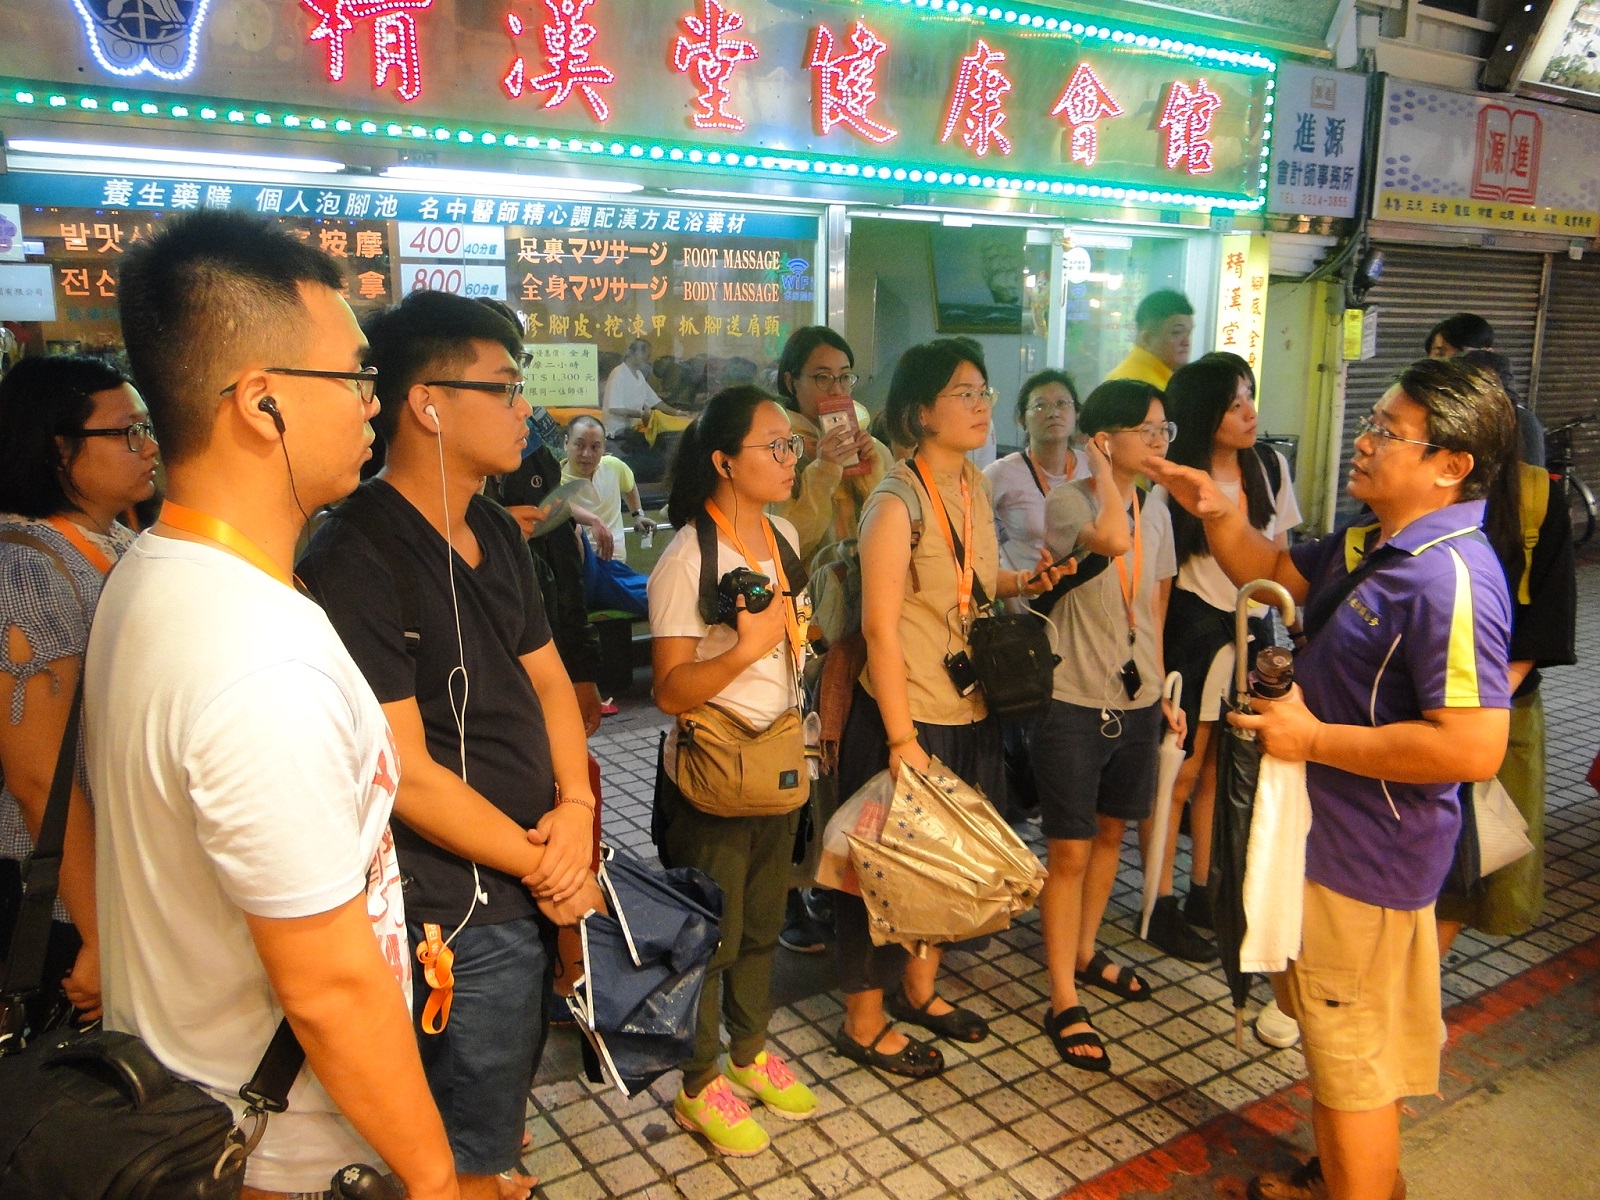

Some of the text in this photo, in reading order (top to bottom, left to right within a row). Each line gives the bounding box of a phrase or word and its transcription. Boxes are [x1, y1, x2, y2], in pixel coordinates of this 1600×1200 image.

[1277, 160, 1354, 191] 會計師事務所
[255, 187, 399, 218] 個人泡腳池
[418, 196, 747, 234] 名中醫師精心調配漢方足浴藥材
[409, 226, 461, 254] 400
[683, 247, 780, 271] FOOT MASSAGE
[683, 281, 718, 302] BODY
[722, 282, 780, 302] MASSAGE
[1222, 252, 1246, 346] 精漢堂
[552, 373, 580, 381] 1,300
